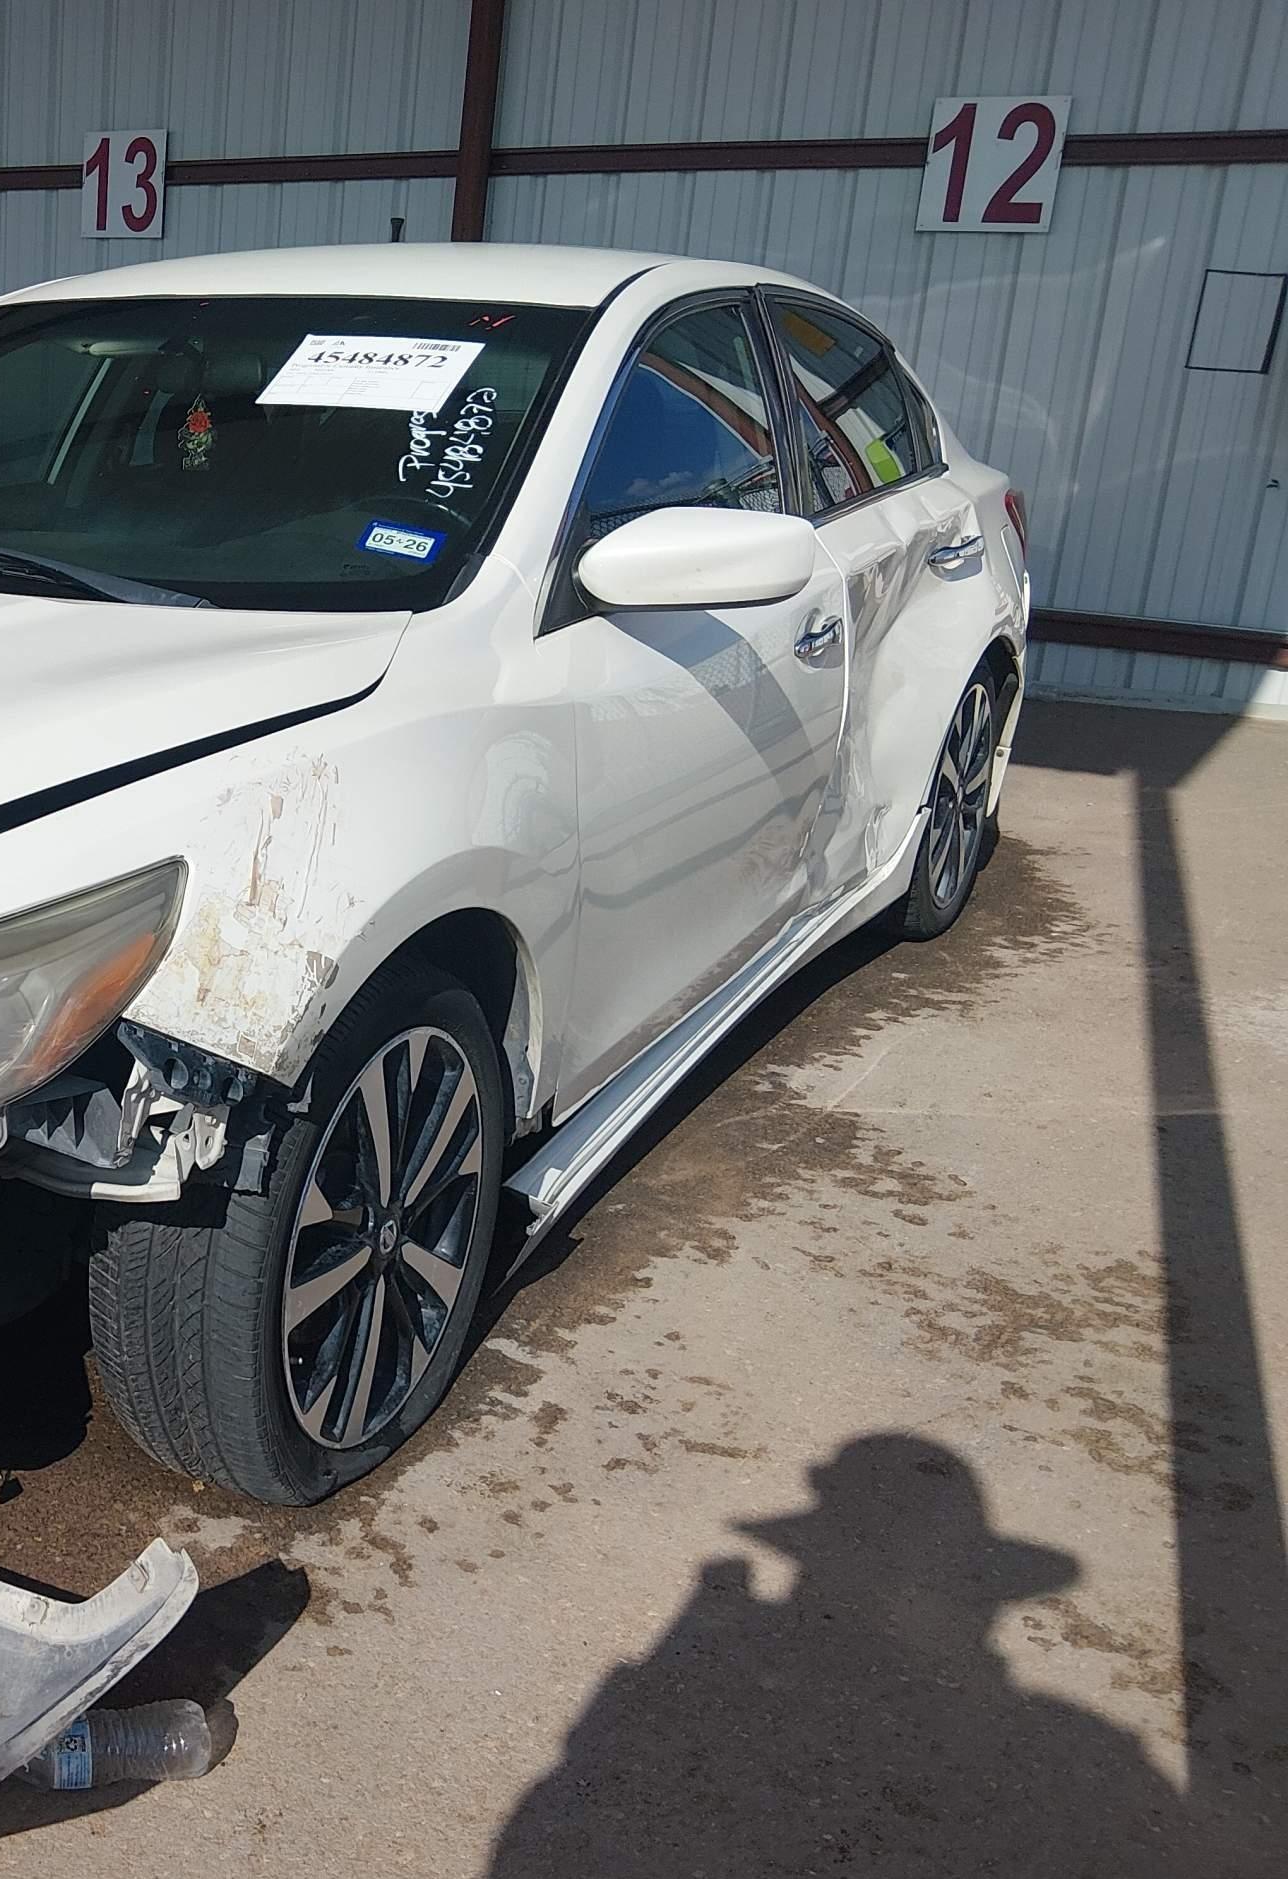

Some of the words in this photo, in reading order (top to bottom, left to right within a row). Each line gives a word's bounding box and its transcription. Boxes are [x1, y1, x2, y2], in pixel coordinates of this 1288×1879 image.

[85, 136, 158, 233] 13
[932, 102, 1056, 224] 12
[307, 350, 448, 369] 45484872
[372, 532, 396, 546] 05
[403, 538, 429, 553] 26
